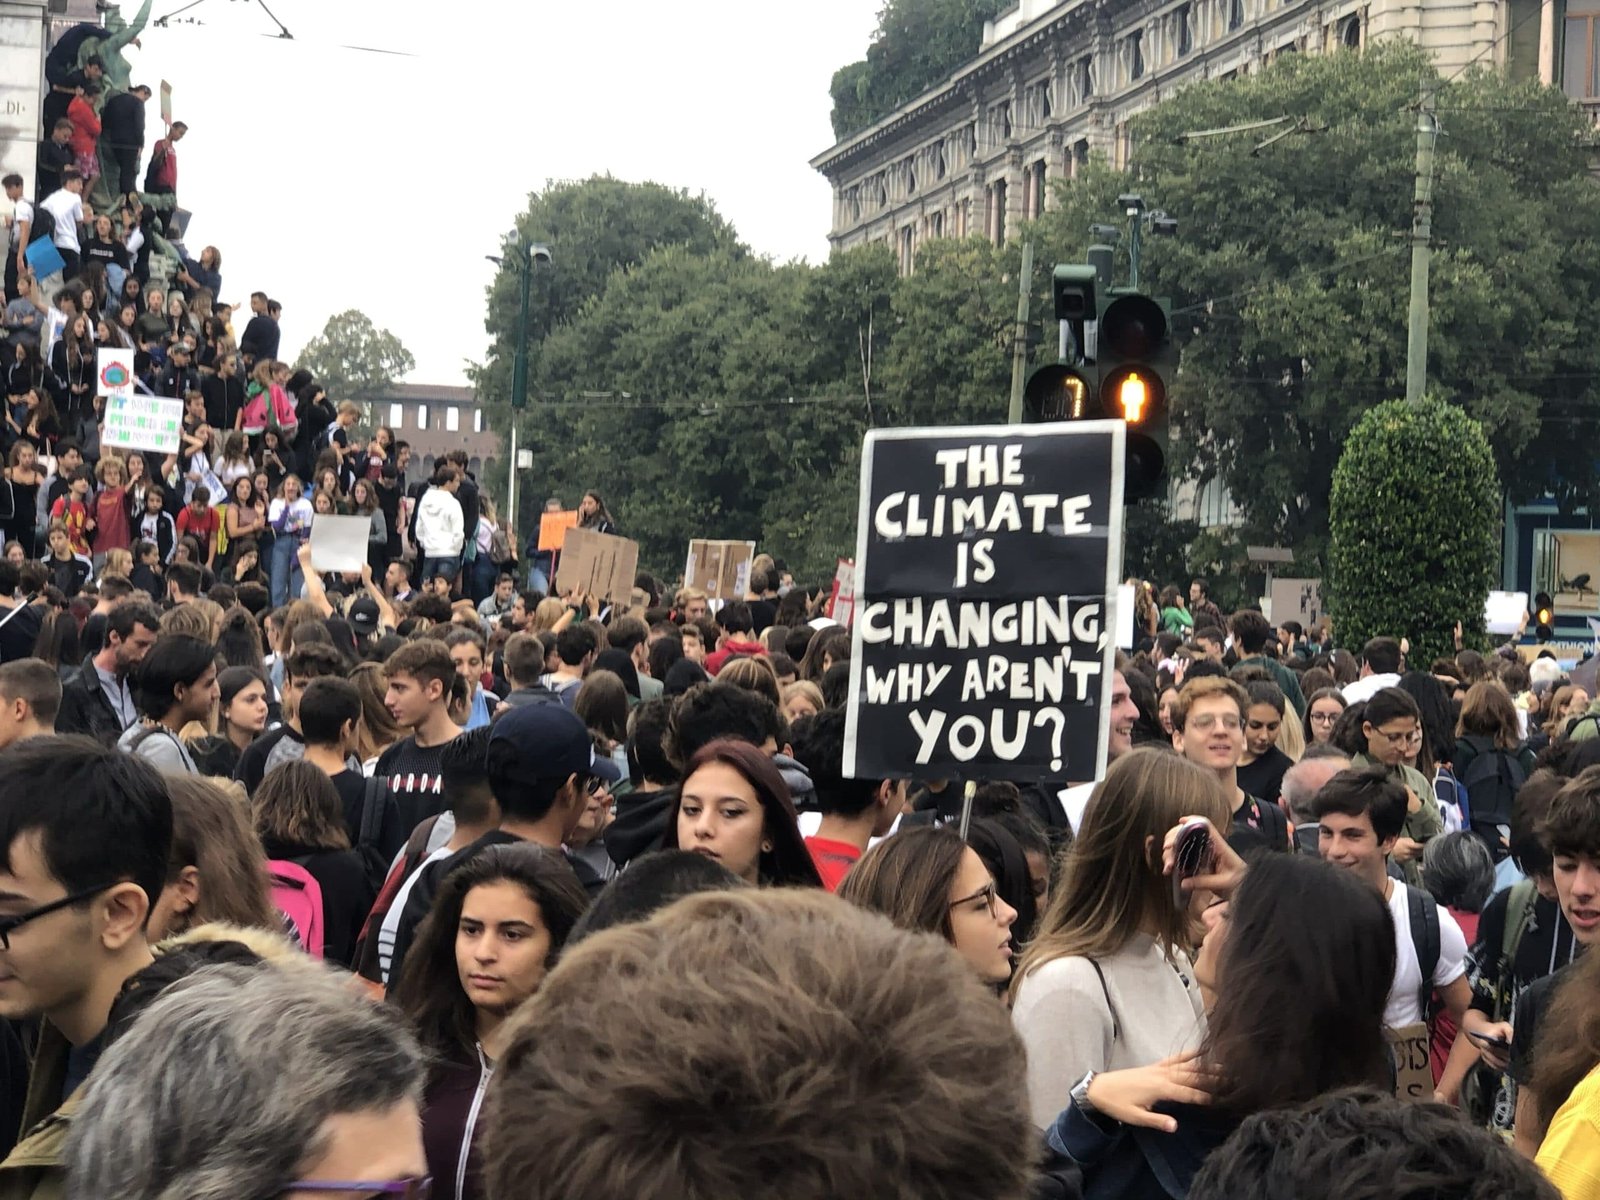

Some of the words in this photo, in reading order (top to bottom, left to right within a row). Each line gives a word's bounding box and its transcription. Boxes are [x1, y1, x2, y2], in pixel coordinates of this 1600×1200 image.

[935, 444, 1024, 488] THE
[874, 491, 1092, 538] CLIMATE
[954, 538, 996, 588] IS
[861, 594, 1109, 654] CHANGING,
[866, 662, 952, 704] WHY
[961, 646, 1101, 703] AREN'T
[908, 706, 1066, 773] YOU?
[386, 772, 445, 795] ORDA
